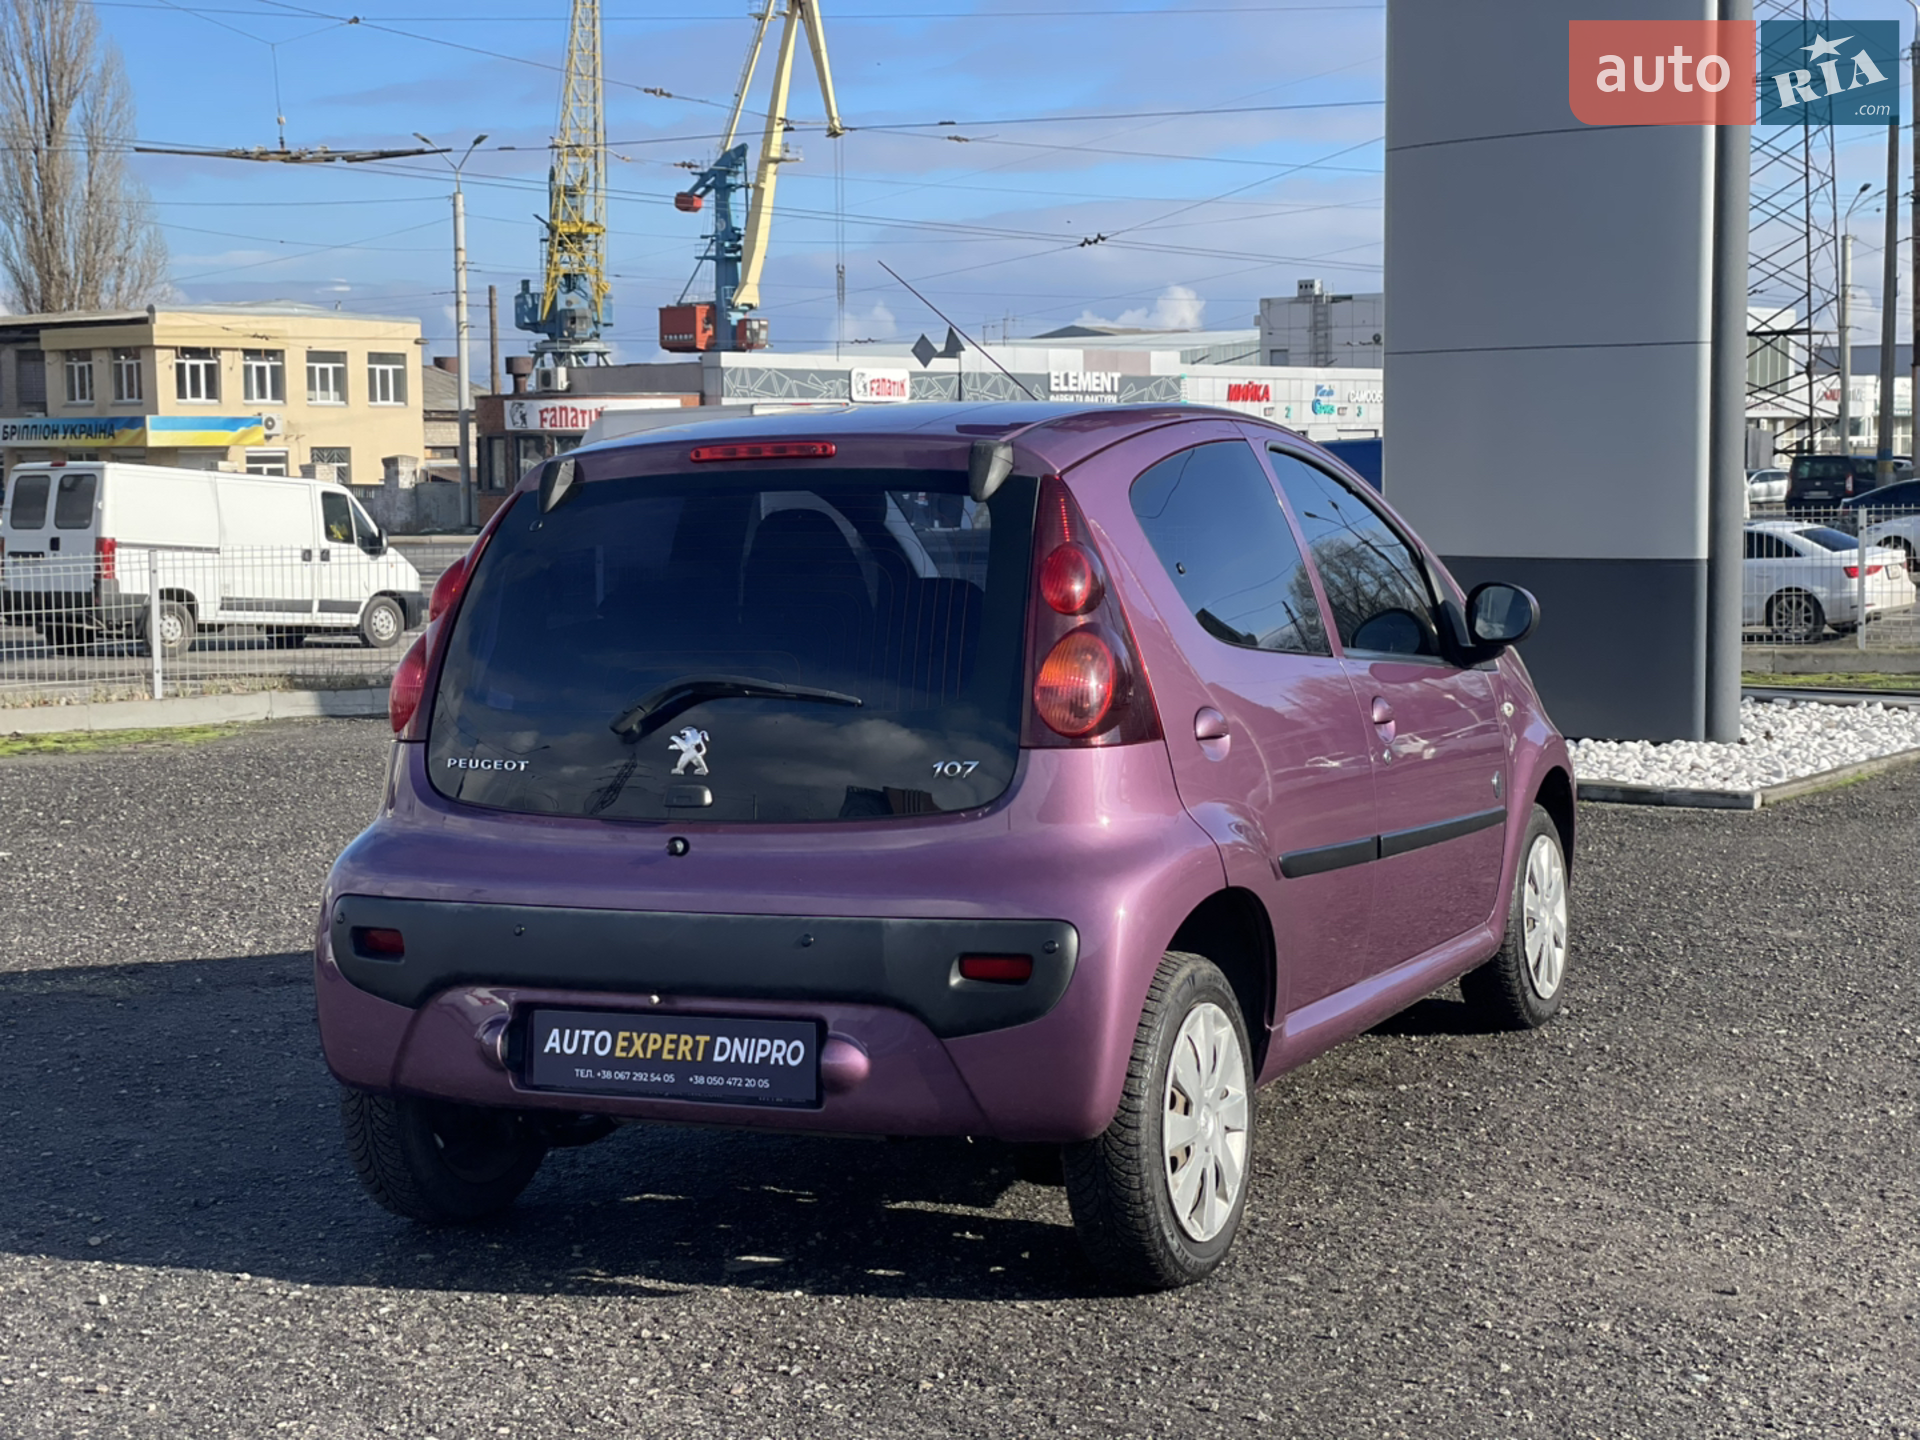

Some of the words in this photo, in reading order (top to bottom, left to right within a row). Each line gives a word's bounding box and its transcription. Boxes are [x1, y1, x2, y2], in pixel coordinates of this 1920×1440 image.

[1050, 371, 1121, 392] ELEMENT
[1227, 381, 1271, 402] МИЙКА
[1285, 406, 1291, 418] 2
[1356, 407, 1362, 417] 3
[447, 757, 530, 772] PEUGEOT
[932, 760, 980, 779] 107
[544, 1028, 613, 1056] AUTO
[614, 1031, 710, 1062] EXPERT
[713, 1036, 805, 1067] DNIPRO
[597, 1069, 613, 1080] +38
[613, 1070, 631, 1081] 067
[632, 1071, 649, 1082] 292
[650, 1072, 662, 1082] 54
[662, 1073, 676, 1084] 05
[689, 1075, 705, 1085] +38
[706, 1075, 725, 1086] 050
[726, 1077, 743, 1088] 472
[744, 1078, 756, 1088] 20
[757, 1078, 770, 1089] 05
